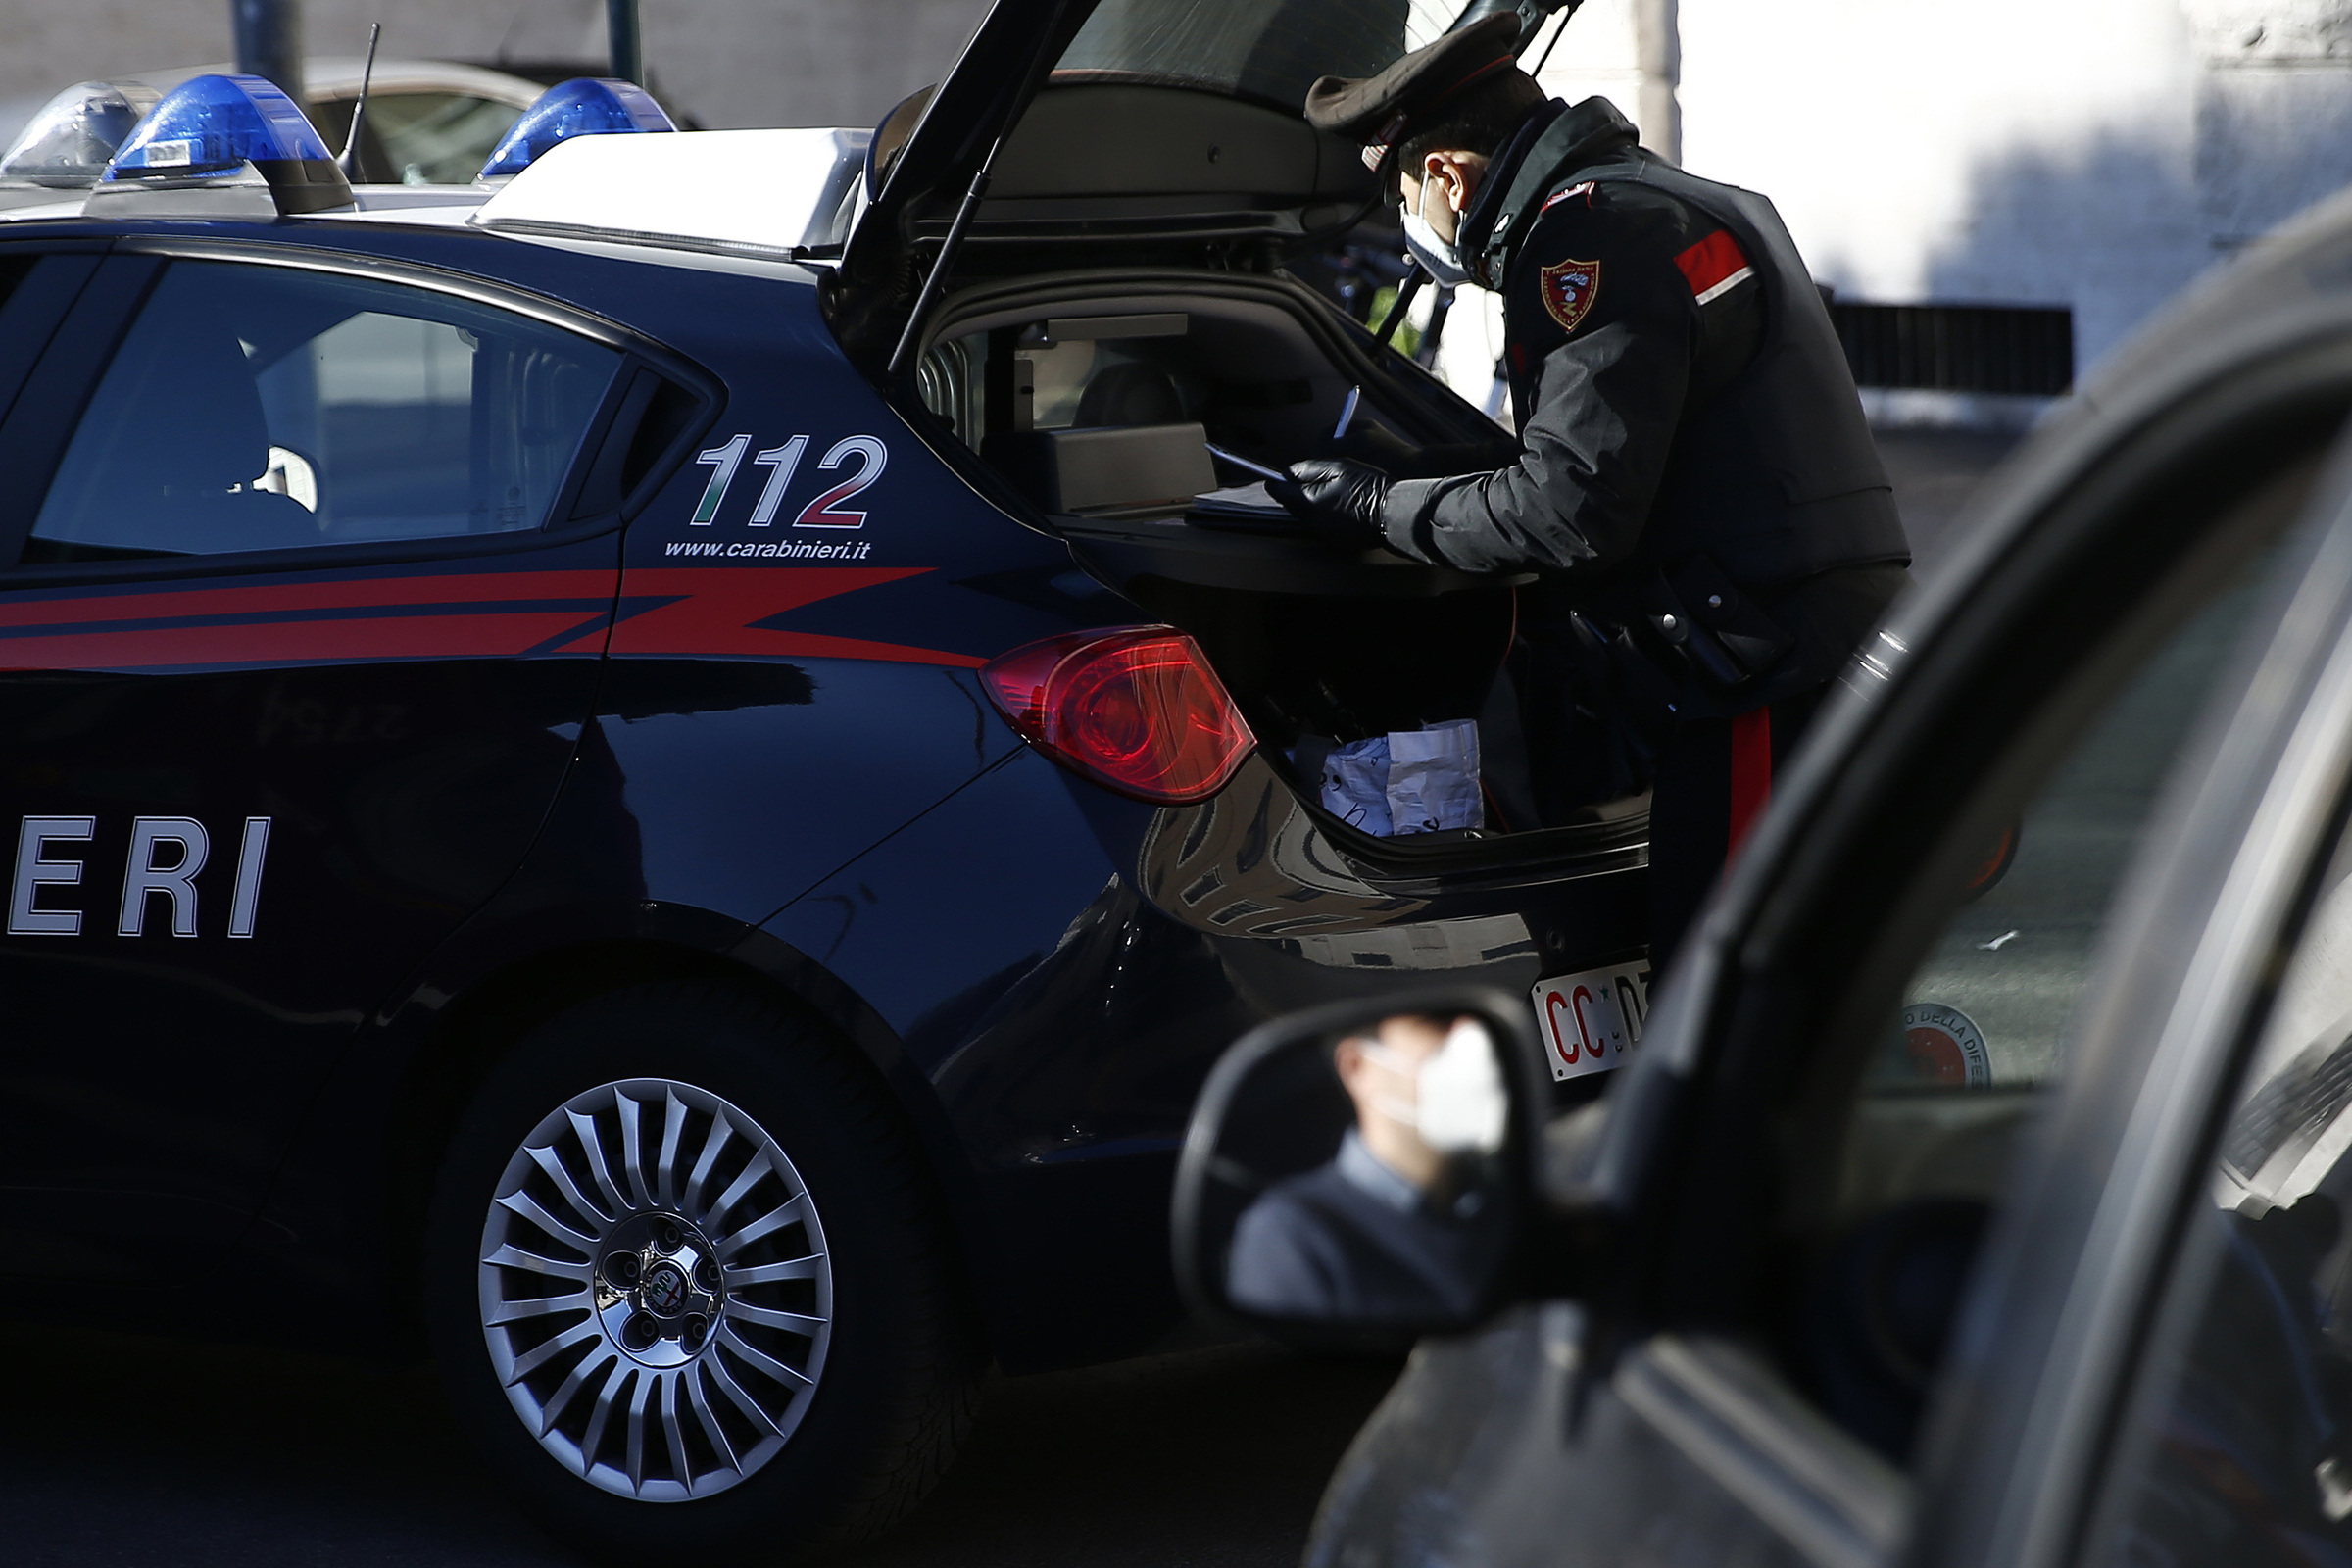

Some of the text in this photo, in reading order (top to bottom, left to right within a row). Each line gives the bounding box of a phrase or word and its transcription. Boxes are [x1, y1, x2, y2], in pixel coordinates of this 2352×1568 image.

[689, 433, 888, 529] 112
[664, 540, 871, 560] www.carabinieri.it
[7, 815, 271, 938] ERI
[1545, 985, 1605, 1064] CC
[1920, 1012, 1966, 1039] DELLA
